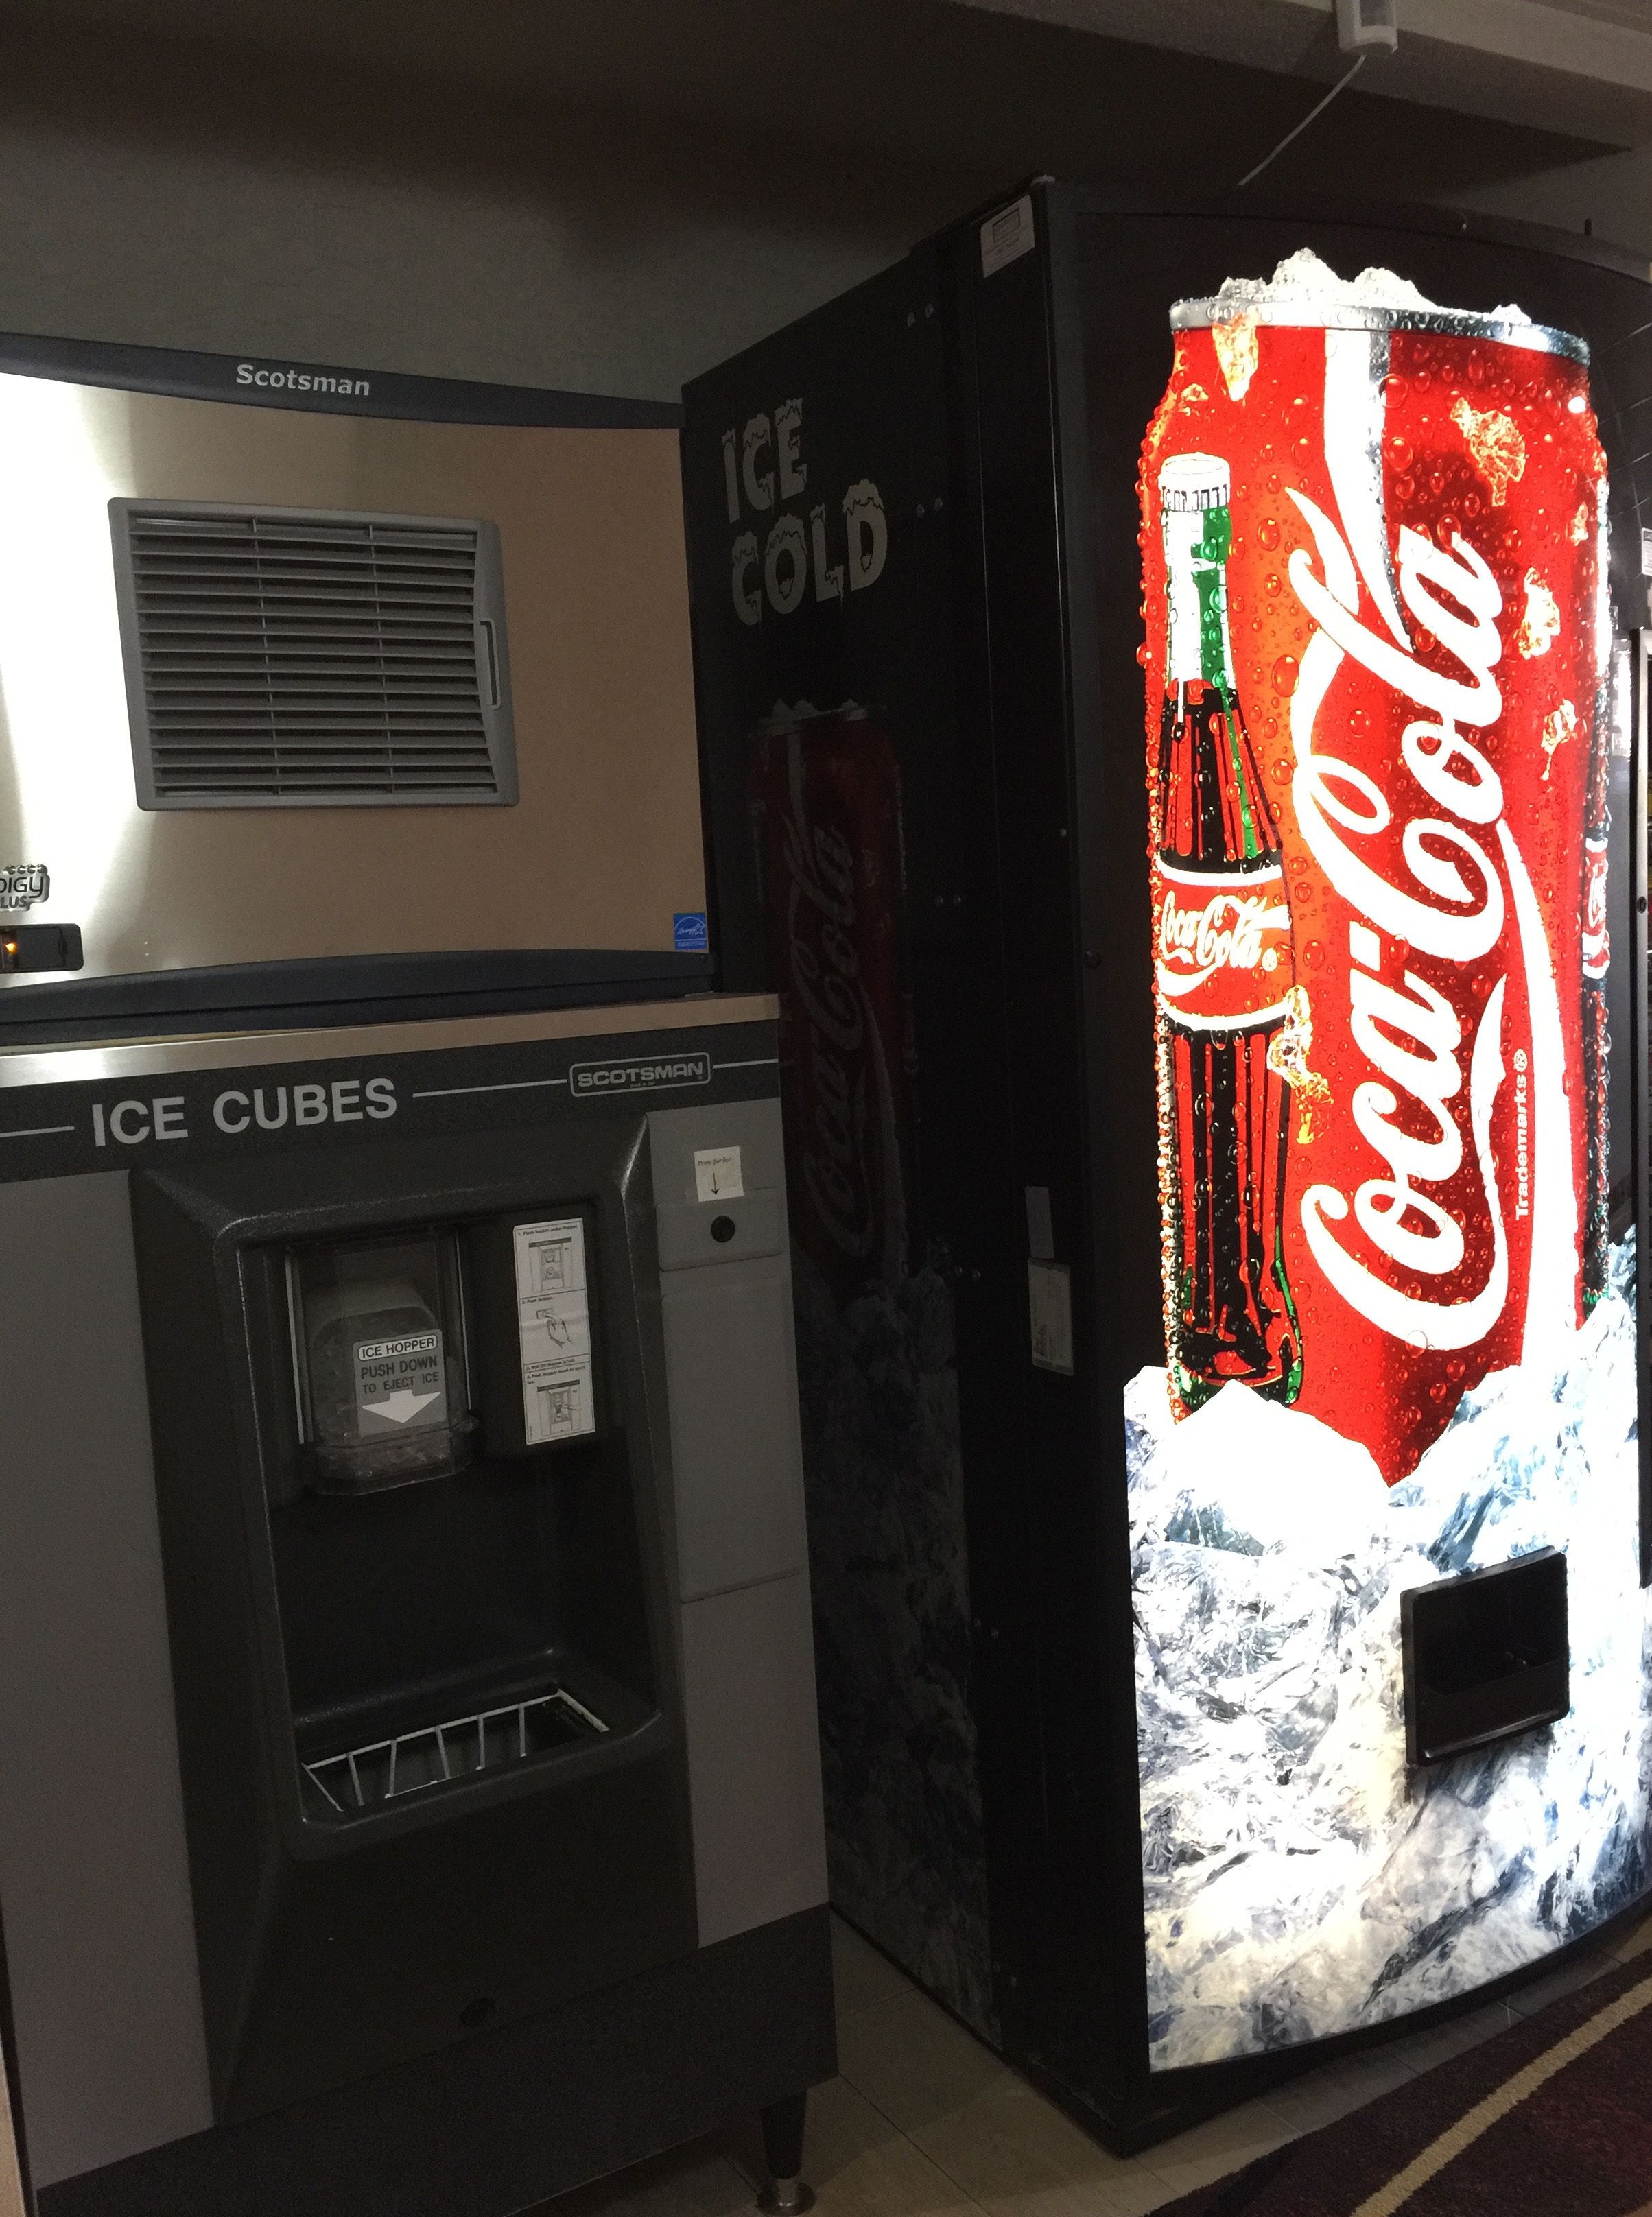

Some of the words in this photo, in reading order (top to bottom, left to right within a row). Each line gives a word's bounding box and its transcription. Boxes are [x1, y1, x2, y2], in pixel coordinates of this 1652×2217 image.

[235, 363, 370, 396] Scotsman
[721, 397, 808, 525] ICE
[731, 478, 888, 626] COLD
[1287, 488, 1508, 1352] Coca-Cola
[577, 1061, 703, 1087] SCOTSMAN
[92, 1095, 189, 1147] ICE
[212, 1077, 398, 1135] CUBES
[362, 1345, 382, 1358] ICE
[386, 1337, 435, 1355] HOPPER
[361, 1362, 395, 1380] PUSH
[399, 1355, 438, 1373] DOWN
[362, 1383, 377, 1395] TO
[383, 1375, 415, 1391] EJECT
[422, 1371, 439, 1384] ICE
